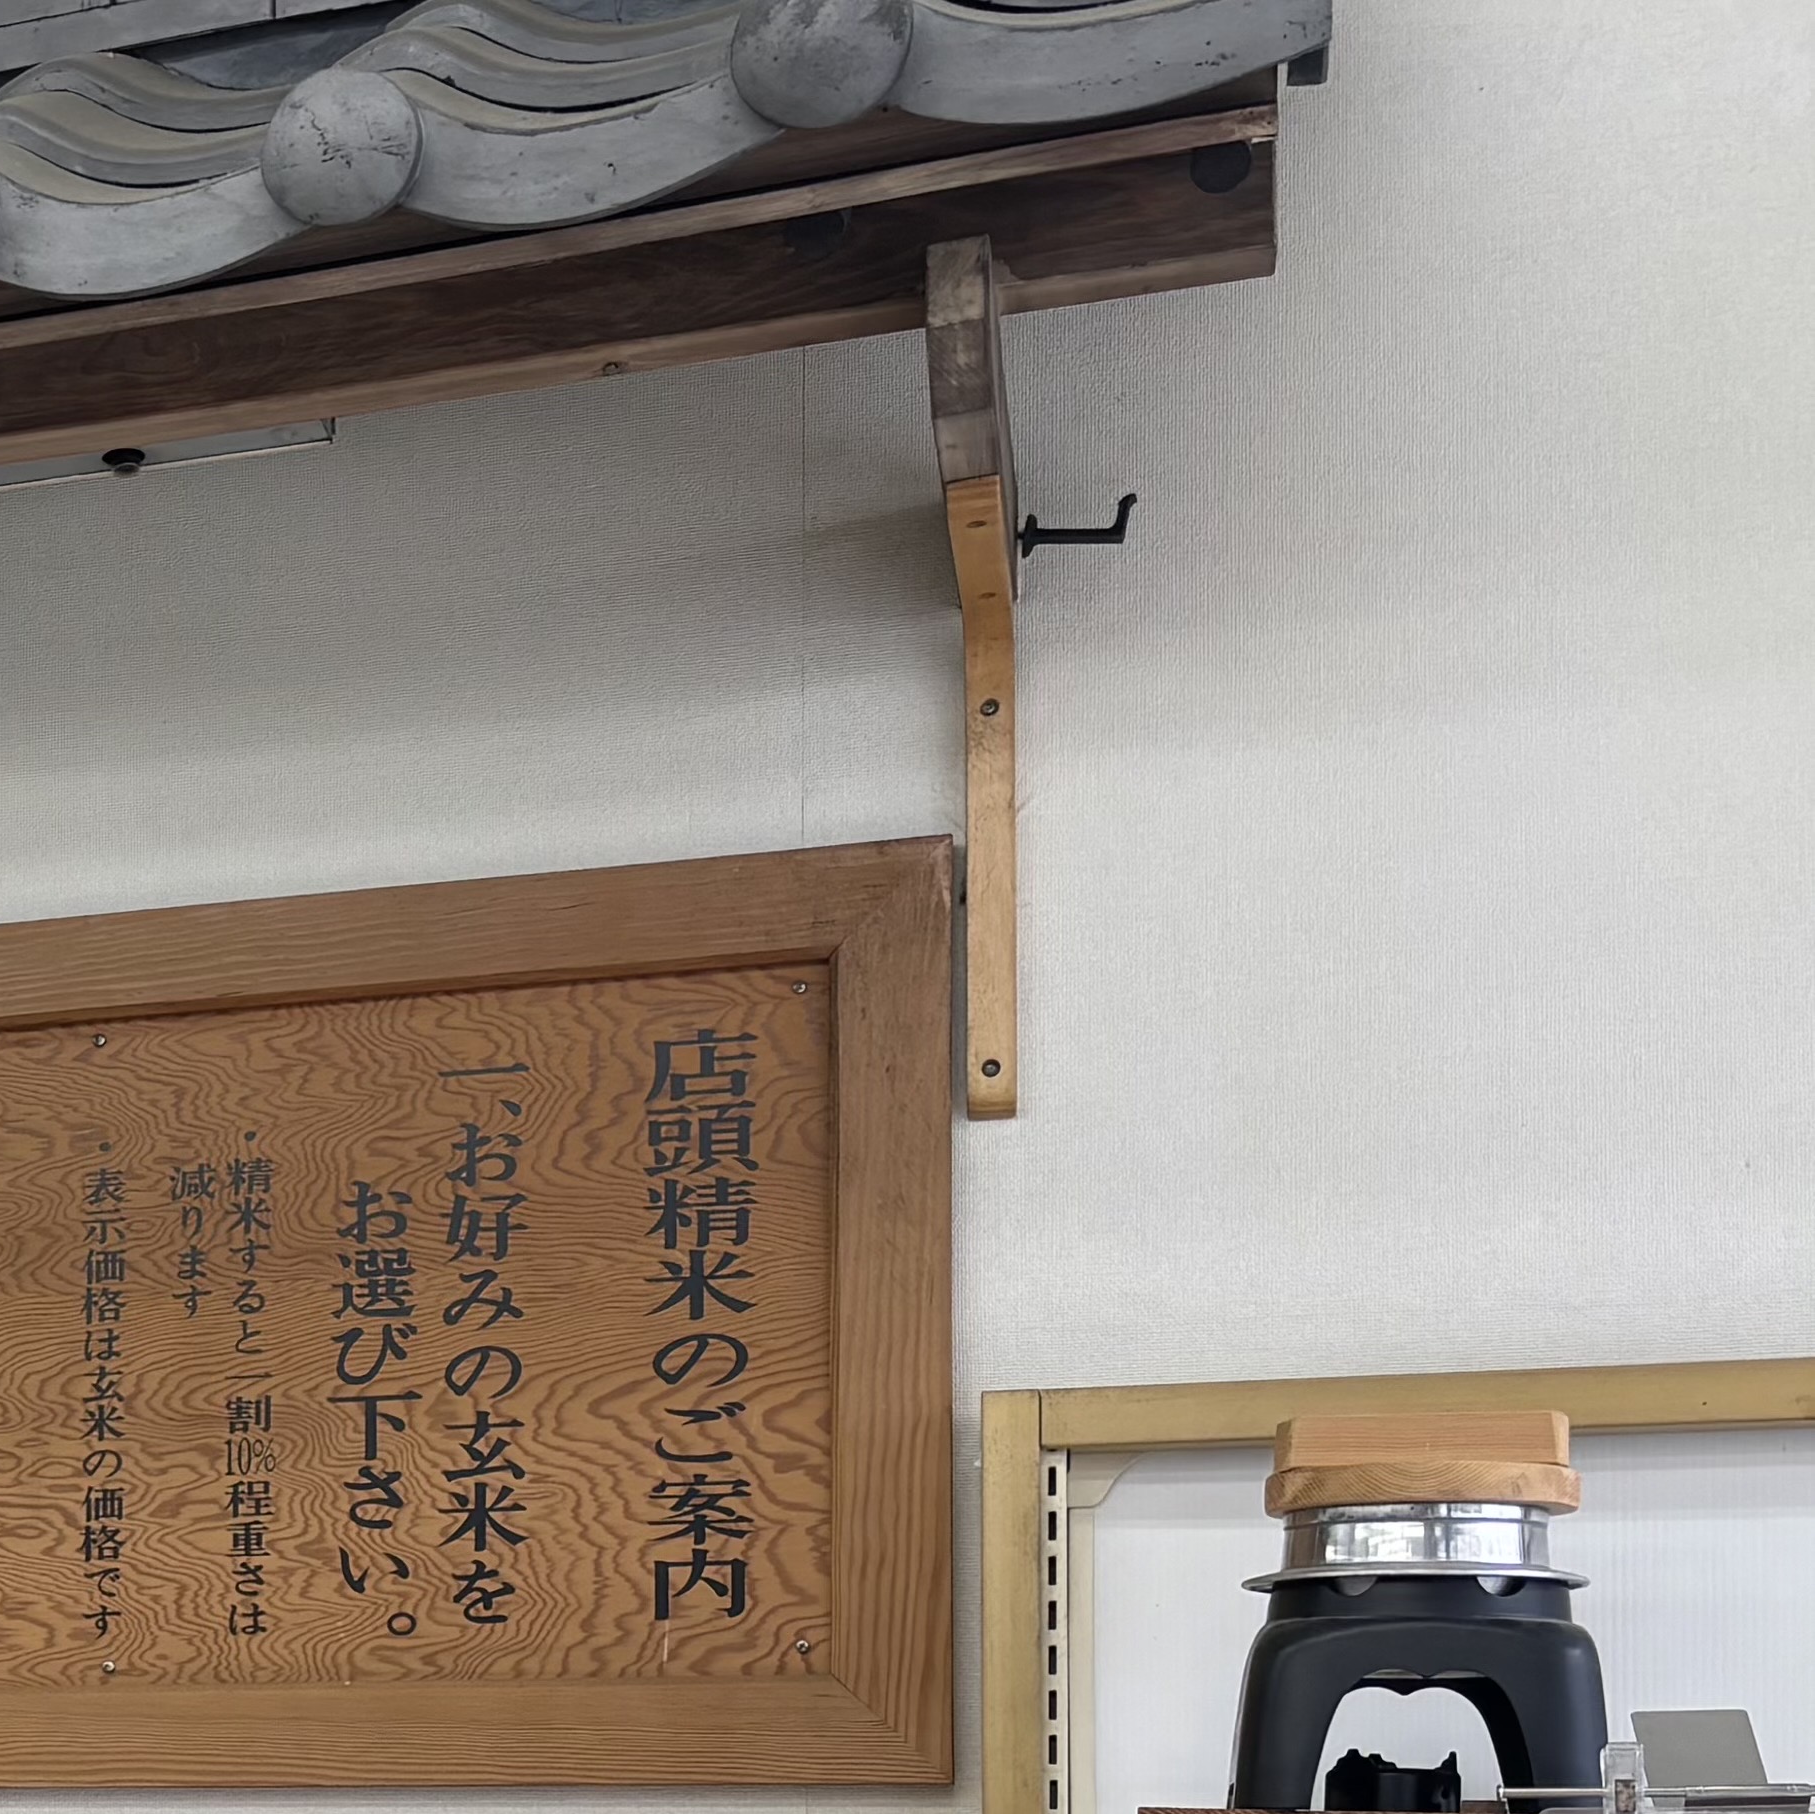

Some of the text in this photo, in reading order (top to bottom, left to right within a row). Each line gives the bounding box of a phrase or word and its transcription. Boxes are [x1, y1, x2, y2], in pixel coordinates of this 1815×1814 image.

[169, 1163, 217, 1318] 減ります
[326, 1181, 423, 1637] お選び下さい。
[437, 1061, 531, 1625] 一、お好みの玄米を
[644, 1027, 759, 1622] 店頭精米のご案内
